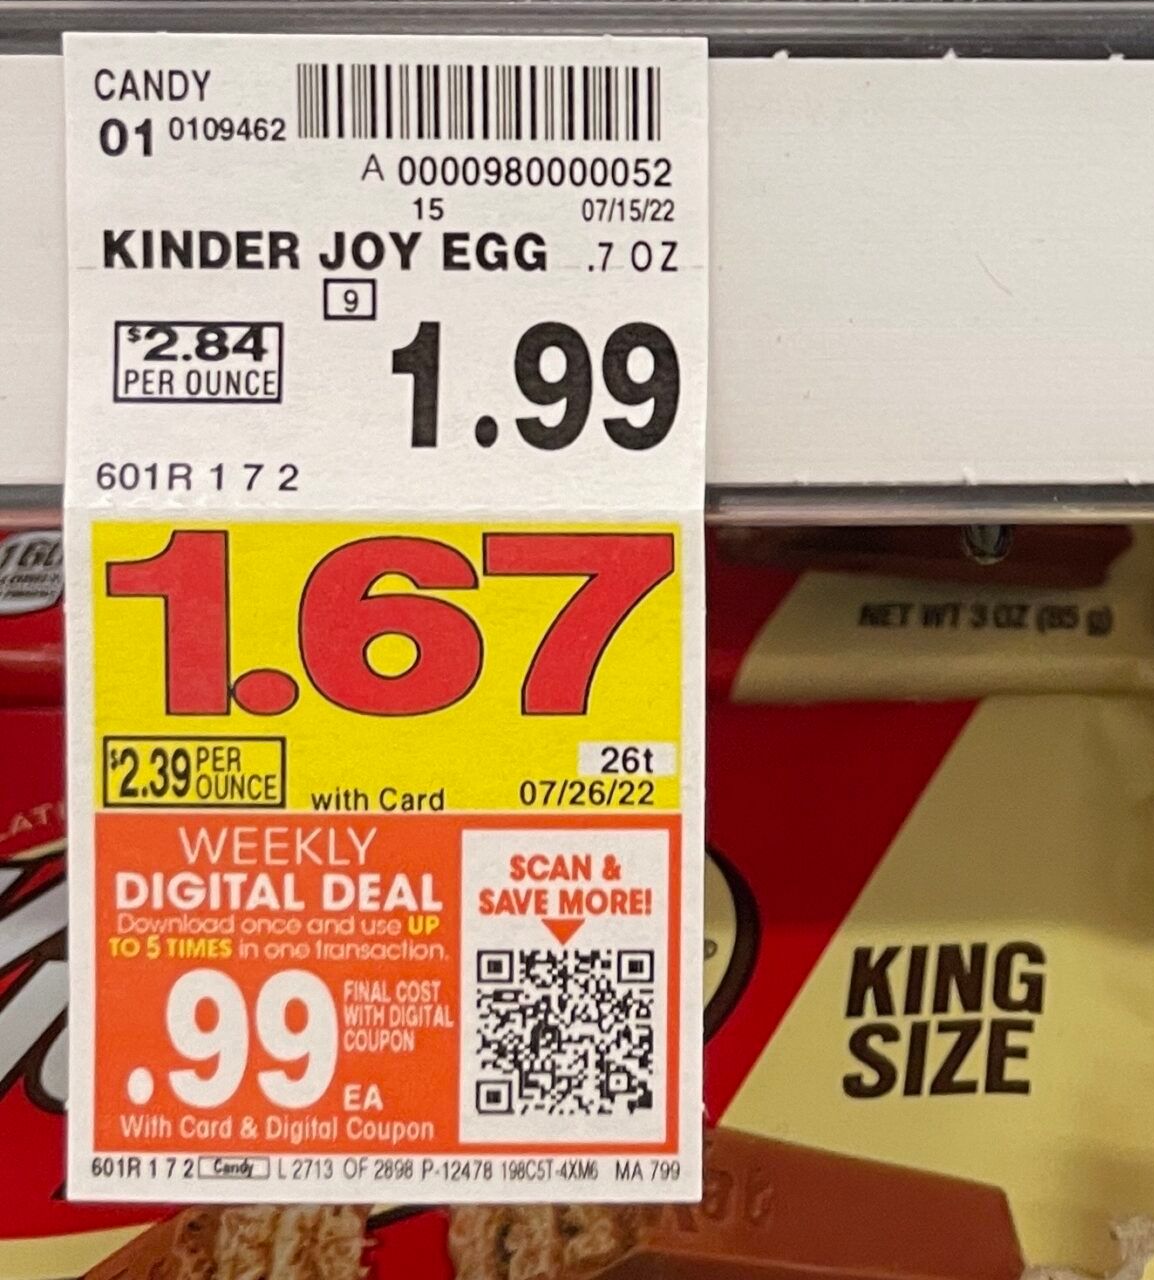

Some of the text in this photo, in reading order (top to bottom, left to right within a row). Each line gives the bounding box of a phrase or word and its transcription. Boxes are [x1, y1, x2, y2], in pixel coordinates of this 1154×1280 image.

[94, 69, 212, 102] CANDY
[98, 117, 287, 157] 01 0109462
[361, 155, 674, 188] A 0000980000052
[413, 197, 675, 223] 15 07/15/22
[103, 229, 301, 270] KINDER
[318, 231, 422, 272] JOY
[443, 232, 548, 272] EGG
[587, 242, 613, 272] .7
[342, 288, 359, 314] 9
[126, 325, 268, 363] $2.84
[124, 369, 277, 397] PER OUNCE
[391, 320, 682, 451] 1.99
[97, 462, 299, 491] 601R 1 7 2
[105, 529, 675, 717] 1.67
[111, 747, 192, 801] $2.39
[196, 747, 242, 773] PER
[600, 747, 656, 774] 26t
[196, 774, 278, 801] OUNCE
[311, 786, 446, 813] with Card
[520, 780, 656, 807] 07/26/22
[178, 827, 379, 866] WEEKLY
[509, 855, 623, 883] SCAN &
[115, 874, 443, 911] DIGITAL DEAL
[479, 888, 654, 917] SAVE MORE!
[116, 914, 440, 935] Download once and use UP
[108, 935, 450, 961] TO 5 TIMES in one transaction.
[343, 979, 442, 1003] FINAL COST
[844, 941, 1047, 1018] KING
[343, 1004, 455, 1028] WITH DIGITAL
[127, 968, 339, 1110] .99
[343, 1028, 415, 1052] COUPON
[841, 1020, 1034, 1099] SIZE
[343, 1084, 384, 1112] EA
[120, 1113, 435, 1145] With Card & Digital Coupon
[91, 1156, 682, 1182] 601R Candy 2713 OF 2898 P-12478 MA 799
